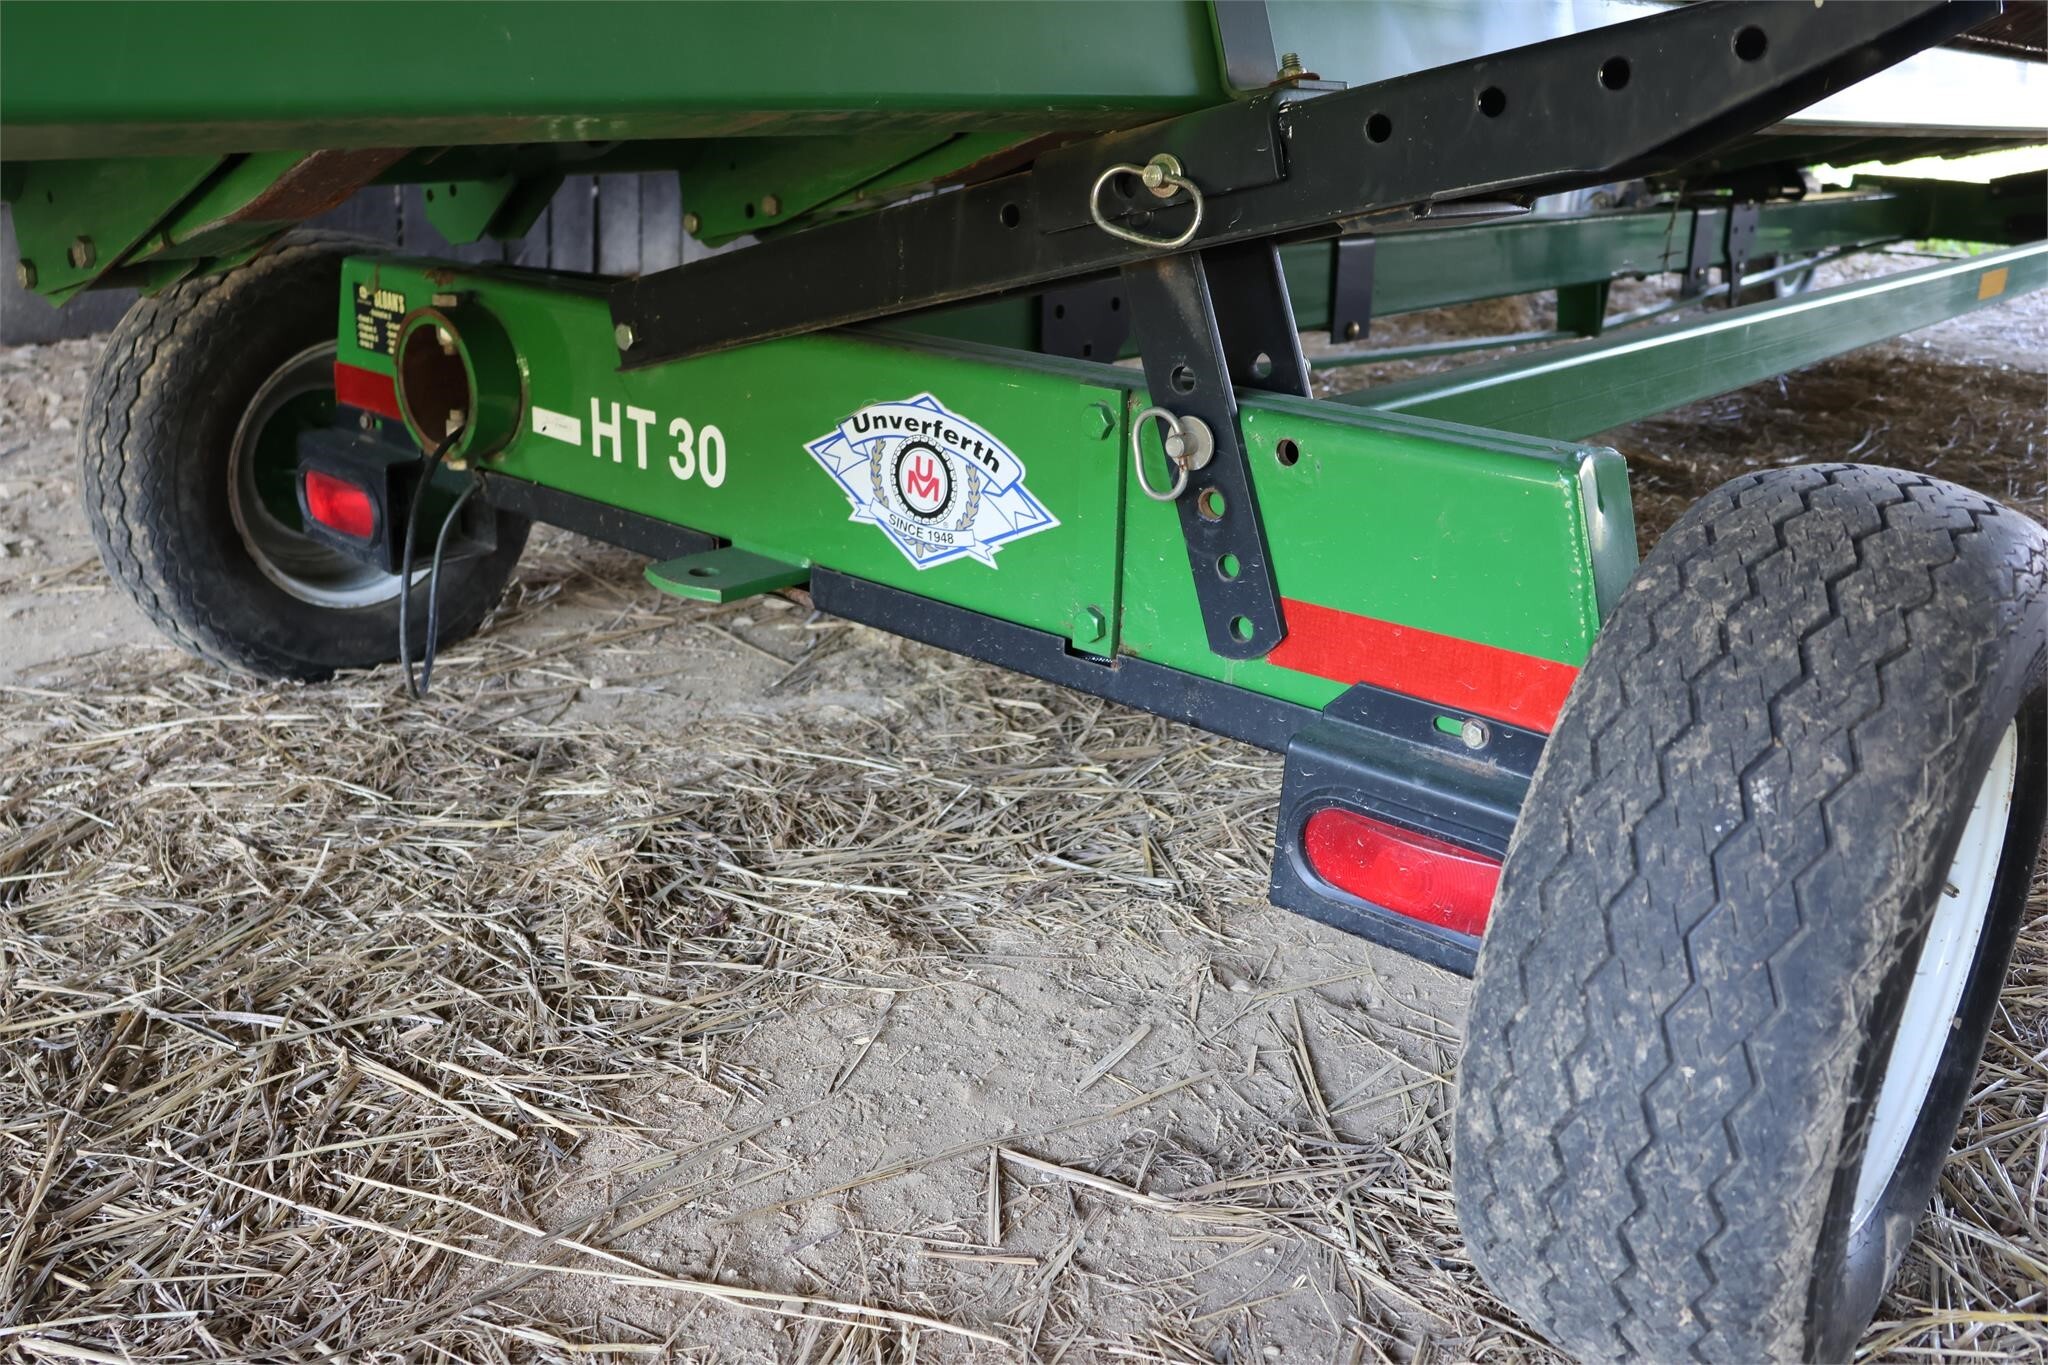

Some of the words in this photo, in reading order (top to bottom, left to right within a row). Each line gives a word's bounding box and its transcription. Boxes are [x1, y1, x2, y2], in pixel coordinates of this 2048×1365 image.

[590, 397, 656, 470] HT
[669, 417, 726, 488] 30
[852, 413, 1001, 473] Unverferth
[888, 513, 924, 539] SINCE
[928, 531, 954, 545] 1948
